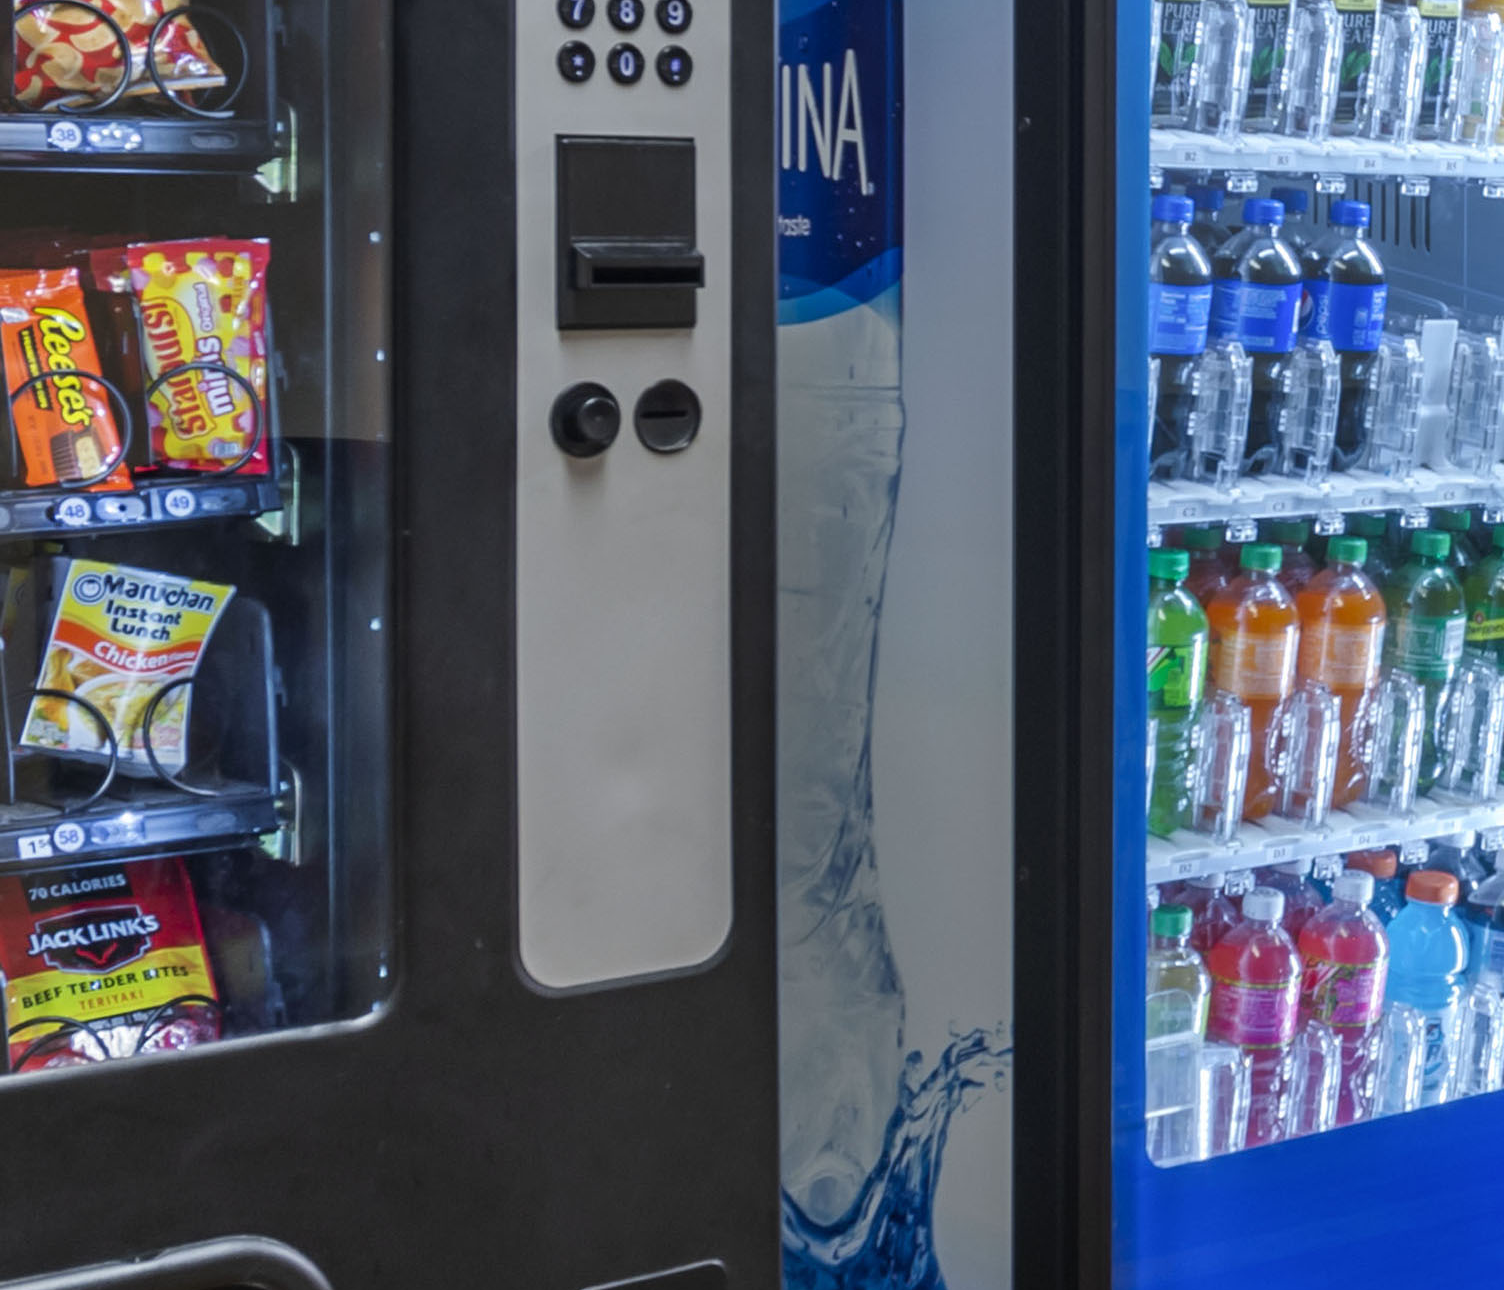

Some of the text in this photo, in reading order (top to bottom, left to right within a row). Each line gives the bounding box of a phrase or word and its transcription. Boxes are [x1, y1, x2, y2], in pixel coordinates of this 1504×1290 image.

[667, 0, 684, 26] 9
[619, 50, 636, 78] 0
[55, 127, 76, 141] 38
[32, 306, 93, 427] Reese's
[65, 505, 85, 519] 48
[170, 497, 190, 509] 49
[102, 573, 215, 612] Maruchan
[104, 599, 183, 628] Instant
[110, 617, 172, 643] Lunch
[94, 639, 167, 671] Chicken
[57, 829, 79, 845] 58
[50, 873, 128, 898] CALORIES
[27, 914, 161, 957] JACK LINK'S
[21, 964, 191, 1010] BEEF TENDER BITES
[79, 989, 146, 1012] TERIYAKI
